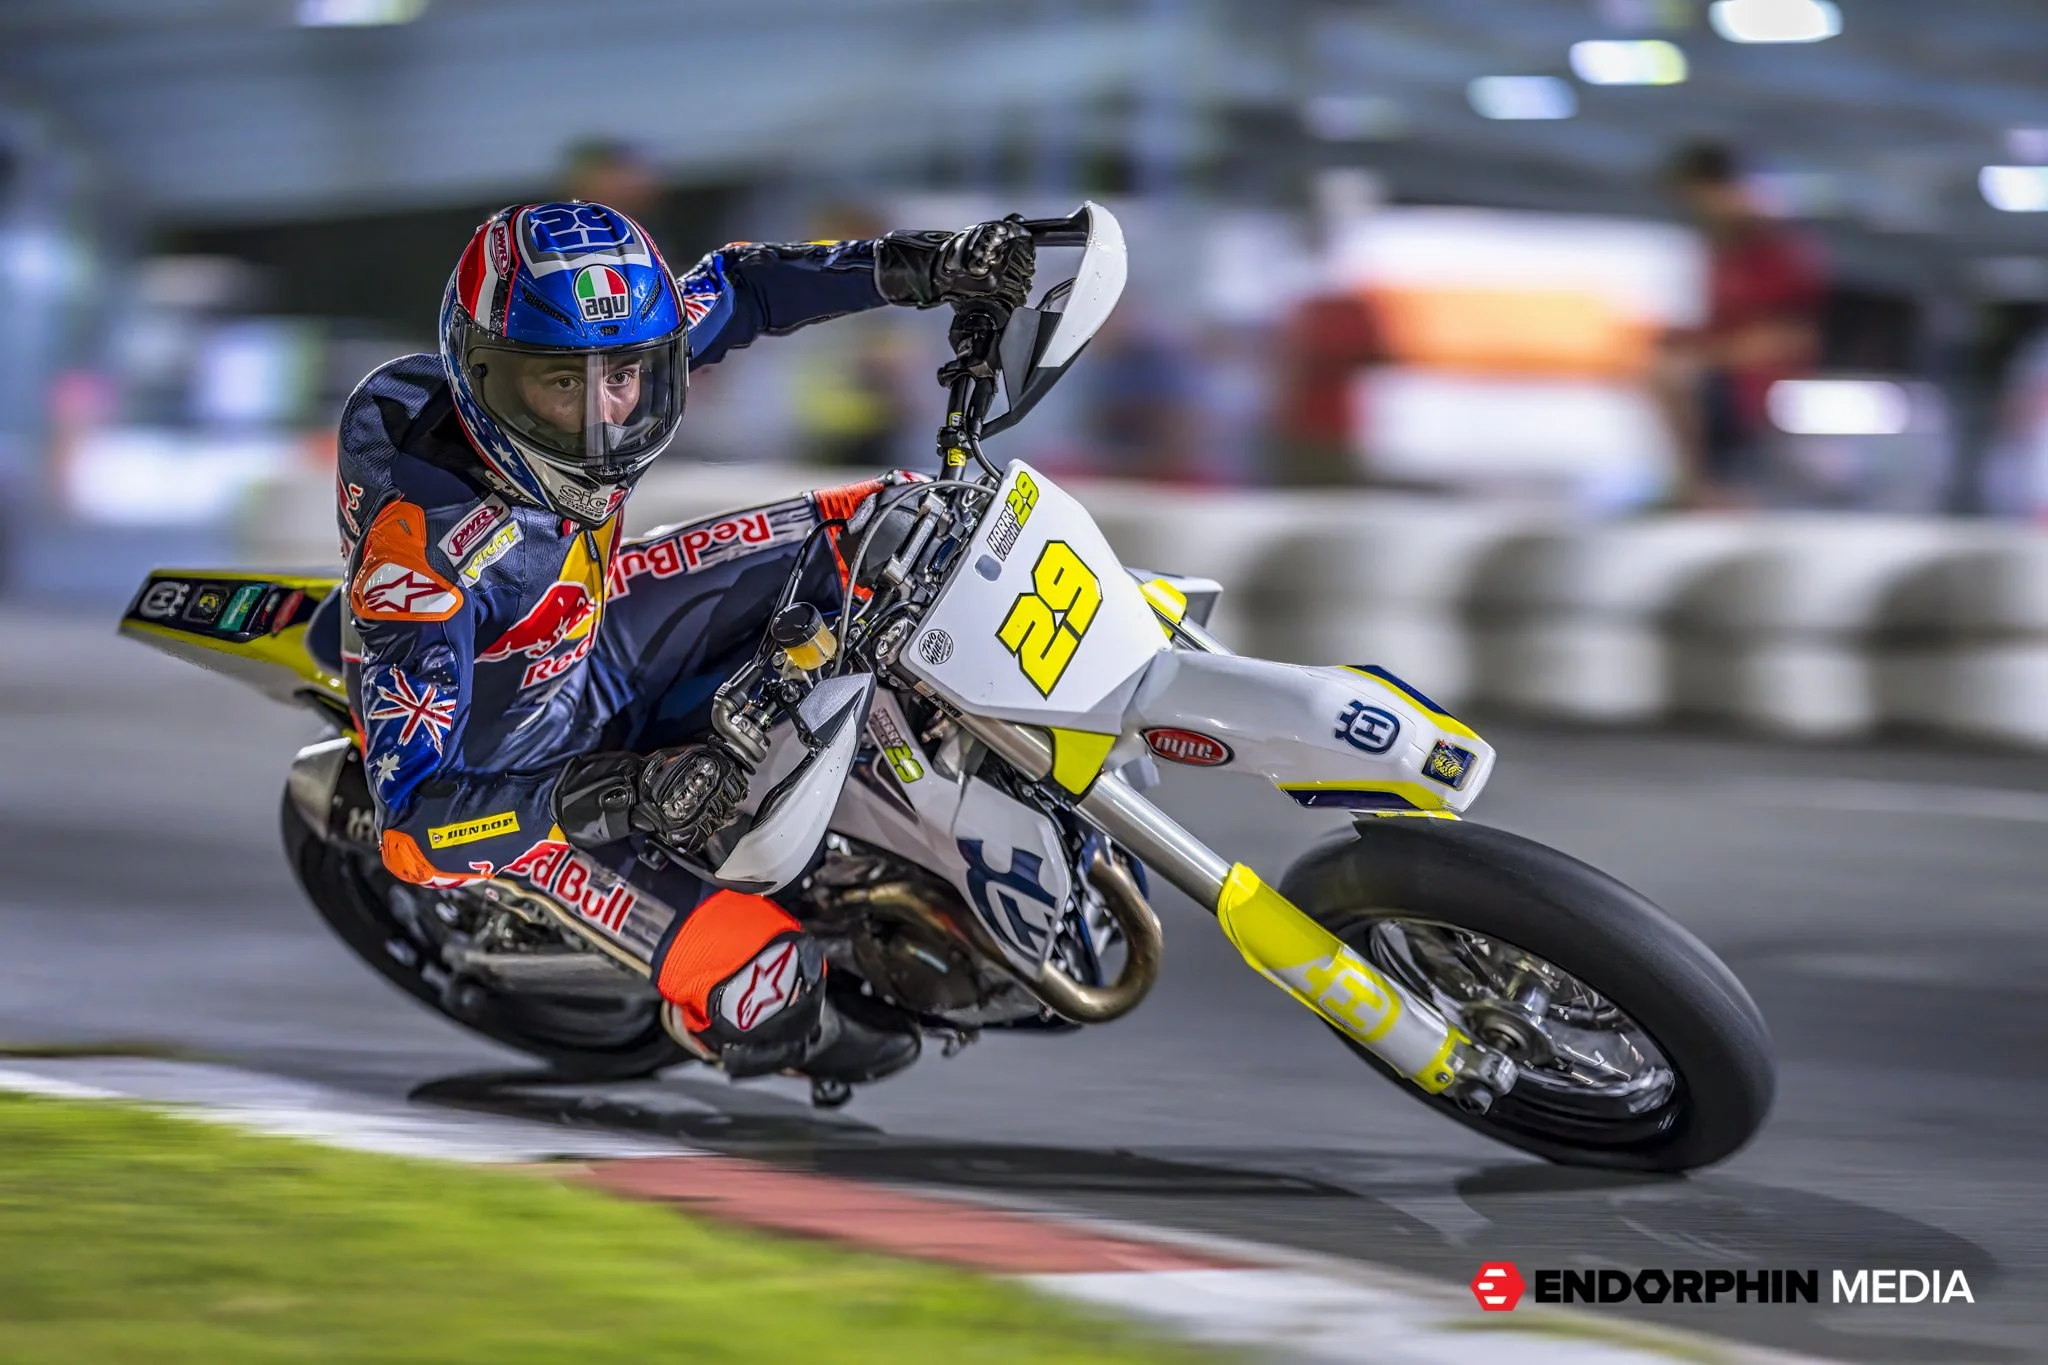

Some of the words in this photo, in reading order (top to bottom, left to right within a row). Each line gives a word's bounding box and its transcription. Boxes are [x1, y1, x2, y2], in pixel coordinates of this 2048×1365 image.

[585, 297, 625, 319] agv
[1006, 471, 1039, 528] 29
[450, 505, 496, 557] PWR
[987, 503, 1018, 552] HARRY
[607, 545, 681, 600] Bul
[922, 632, 936, 654] TWO
[995, 540, 1103, 700] 29
[522, 622, 597, 688] Red
[926, 632, 945, 664] WHEEL
[447, 817, 513, 840] DUNLOP
